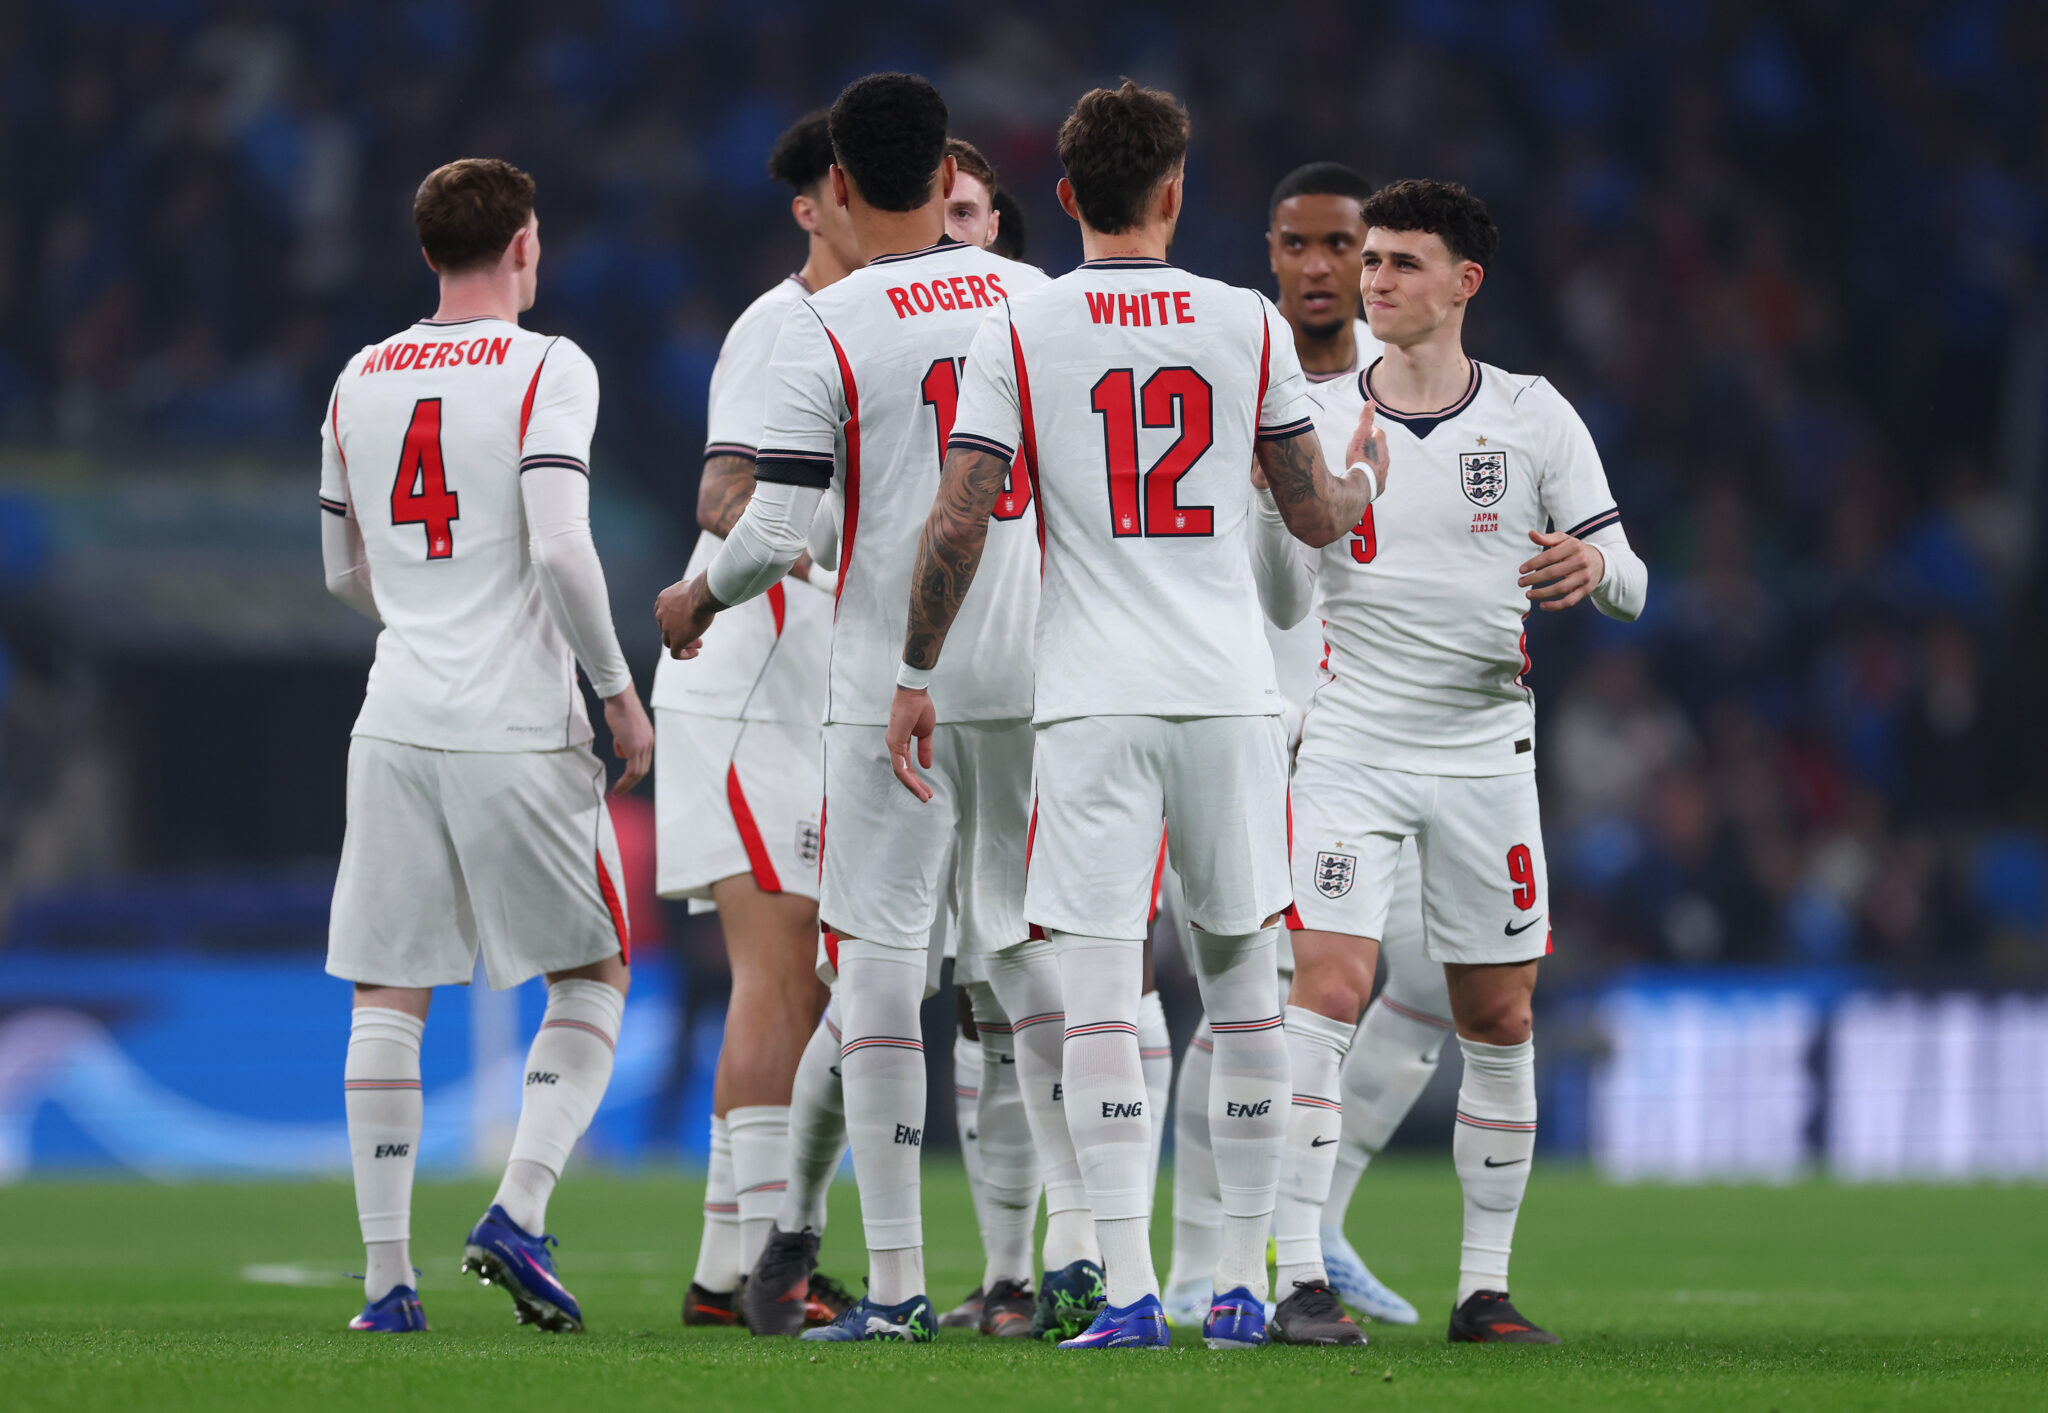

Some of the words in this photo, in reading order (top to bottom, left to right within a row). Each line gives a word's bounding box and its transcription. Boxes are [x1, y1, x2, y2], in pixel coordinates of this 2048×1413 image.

[886, 273, 1008, 319] ROGERS
[1085, 291, 1195, 327] WHITE
[359, 338, 512, 376] ANDERSON
[1090, 366, 1214, 538] 12
[390, 397, 459, 560] 4
[1470, 523, 1498, 533] 31.03.26
[1472, 513, 1498, 522] JAPAN
[1507, 843, 1536, 911] 9
[526, 1071, 560, 1086] ENG
[1102, 1101, 1142, 1118] ENG
[1226, 1099, 1271, 1118] ENG
[894, 1123, 921, 1146] ENG
[375, 1144, 409, 1158] ENG
